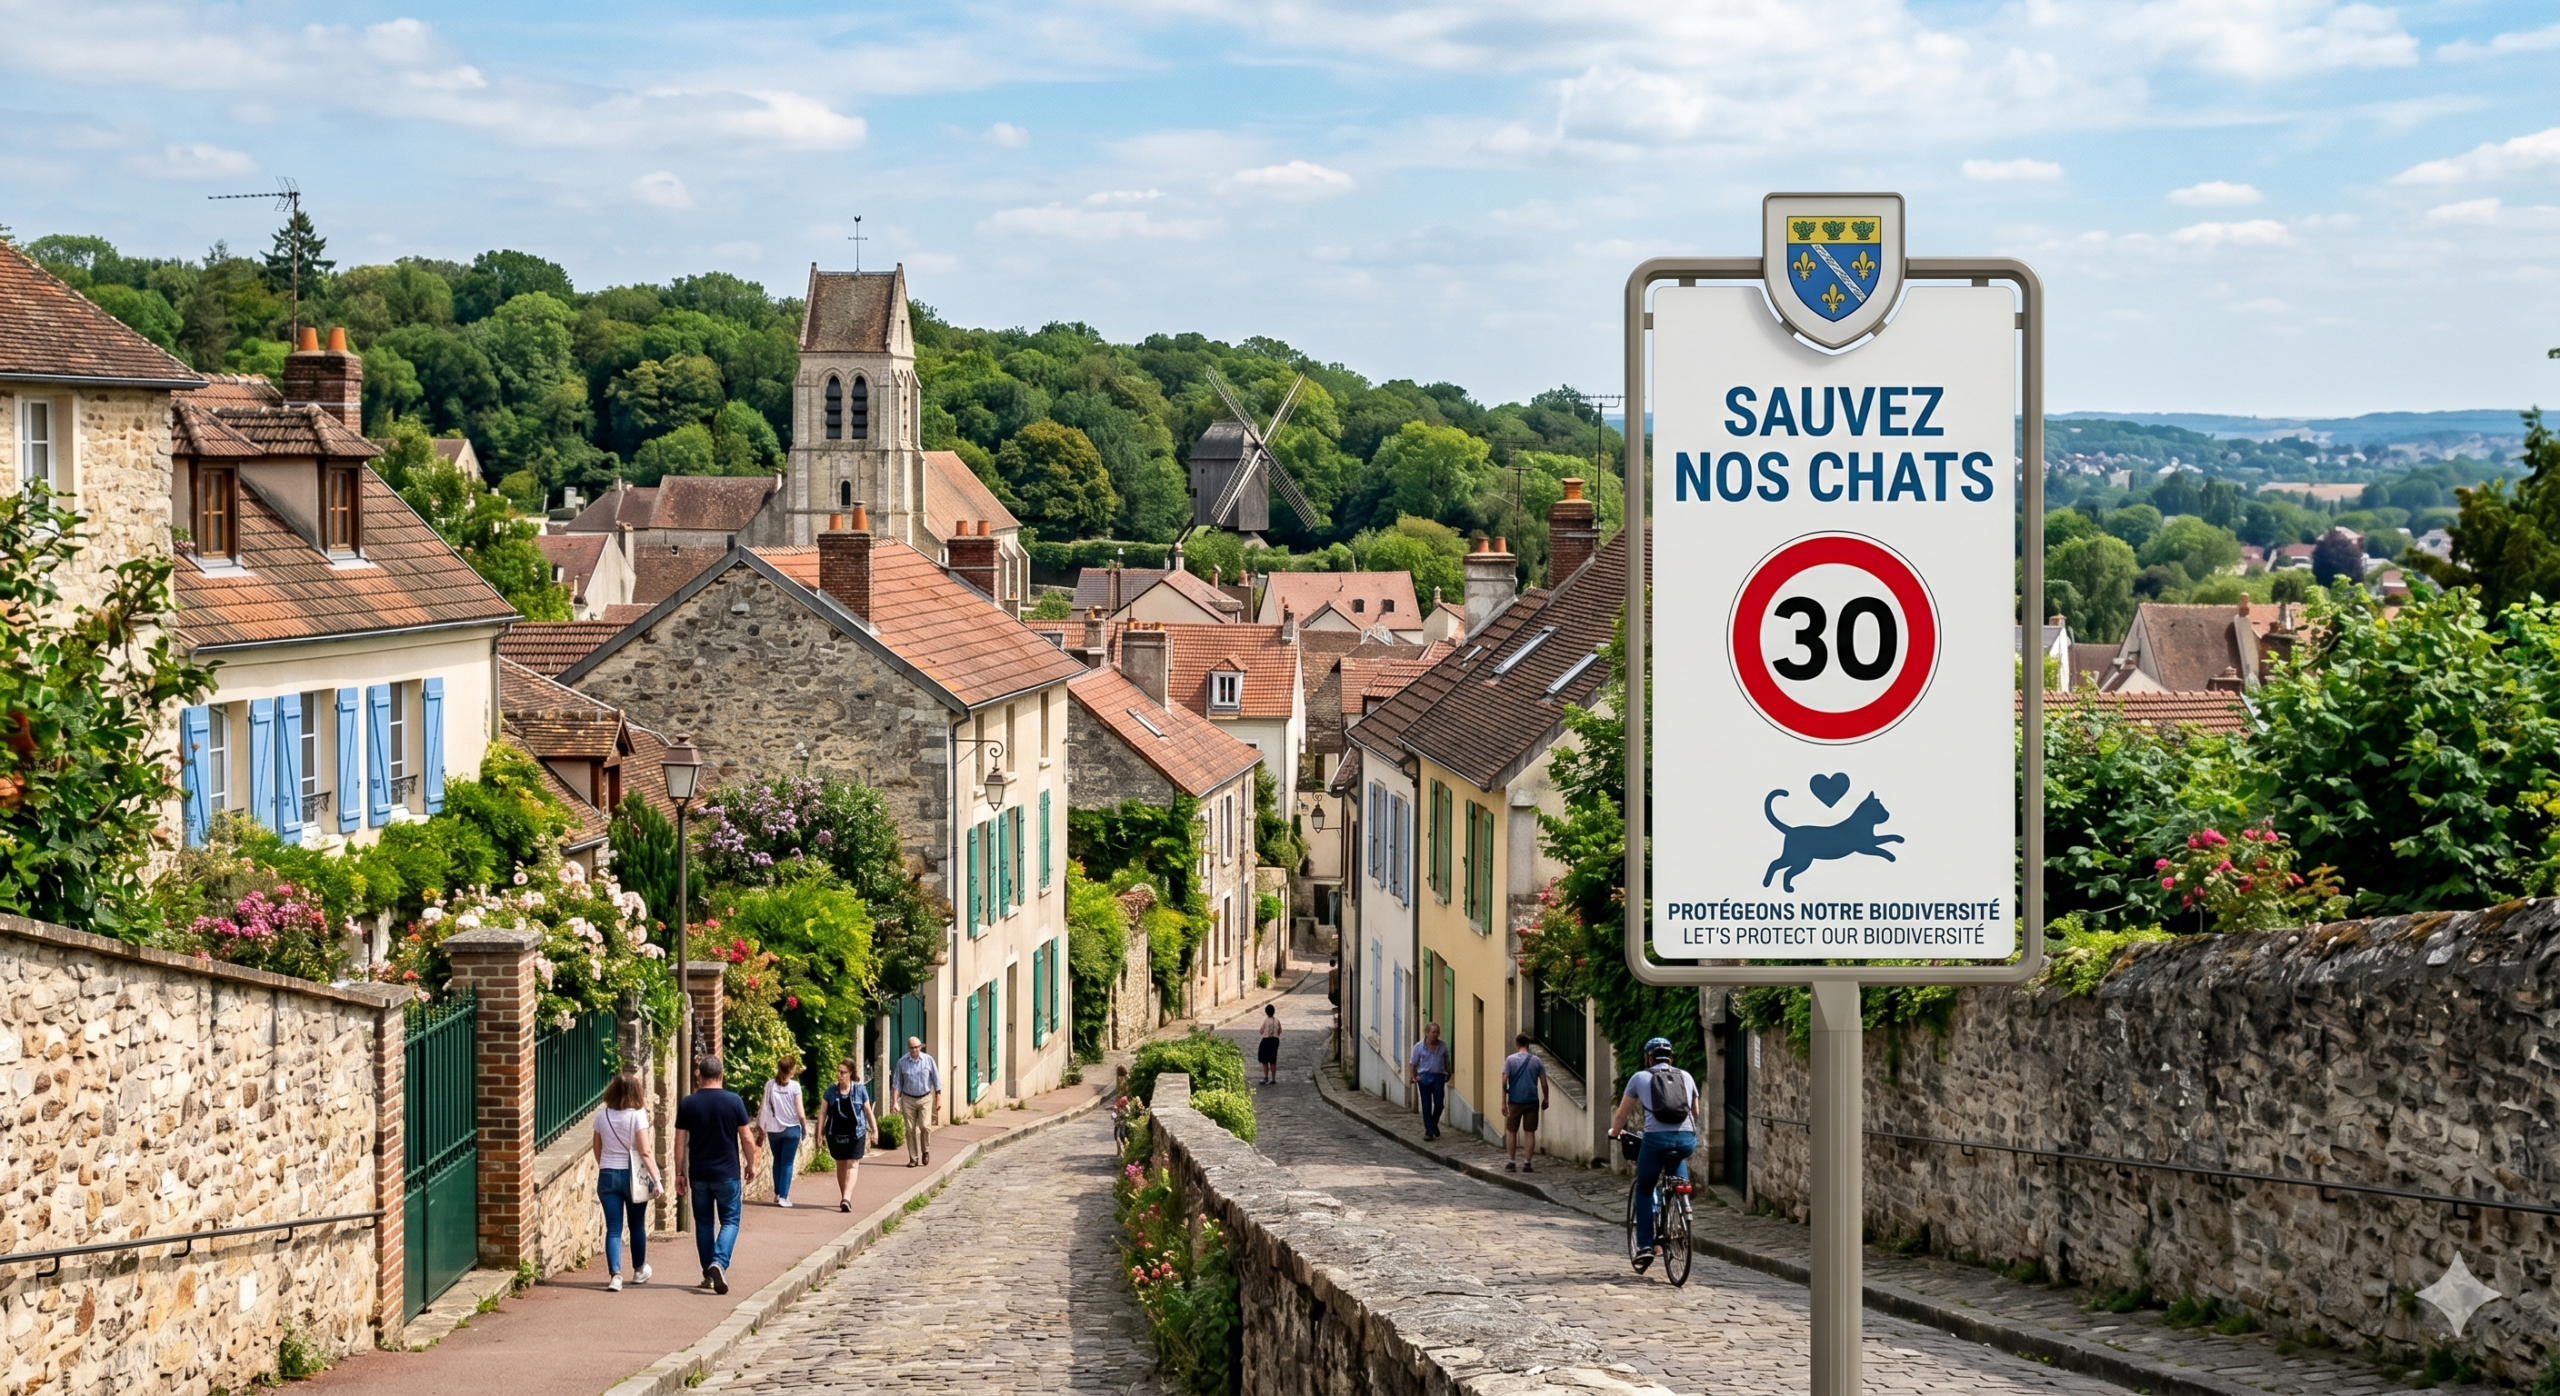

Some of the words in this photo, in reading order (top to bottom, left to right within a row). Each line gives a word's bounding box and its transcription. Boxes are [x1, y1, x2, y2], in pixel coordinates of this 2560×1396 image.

[1724, 386, 1944, 436] SAUVEZ
[1676, 452, 1789, 502] NOS
[1809, 452, 1993, 502] CHATS
[1772, 596, 1899, 682] 30
[1668, 898, 1794, 921] PROTÉGEONS
[1801, 902, 1863, 921] NOTRE
[1870, 898, 2000, 921] BIODIVERSITÉ
[1683, 927, 1731, 944] LET'S
[1737, 927, 1816, 944] PROTECT
[1822, 927, 1858, 944] OUR
[1864, 923, 1985, 944] BIODIVERSITÉ
